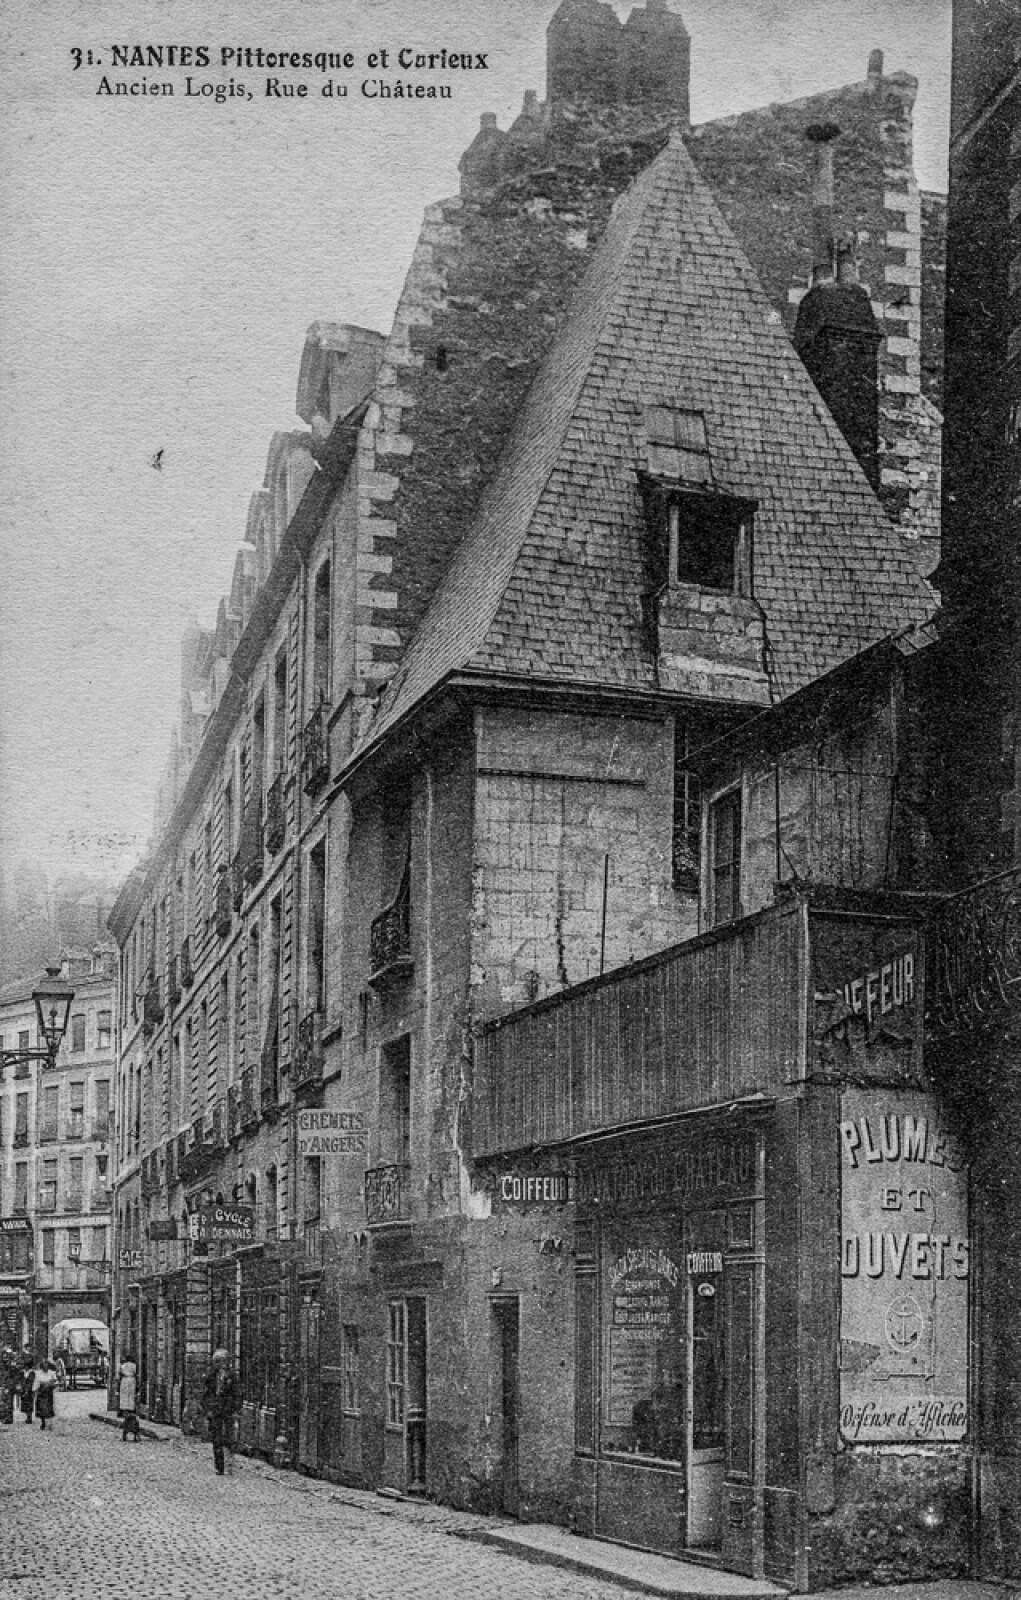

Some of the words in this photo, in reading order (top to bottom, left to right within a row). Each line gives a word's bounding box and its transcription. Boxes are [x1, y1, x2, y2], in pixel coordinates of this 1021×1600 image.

[501, 1175, 567, 1201] COIFFEUR
[881, 1188, 931, 1212] ET
[841, 1232, 969, 1281] DUVETS
